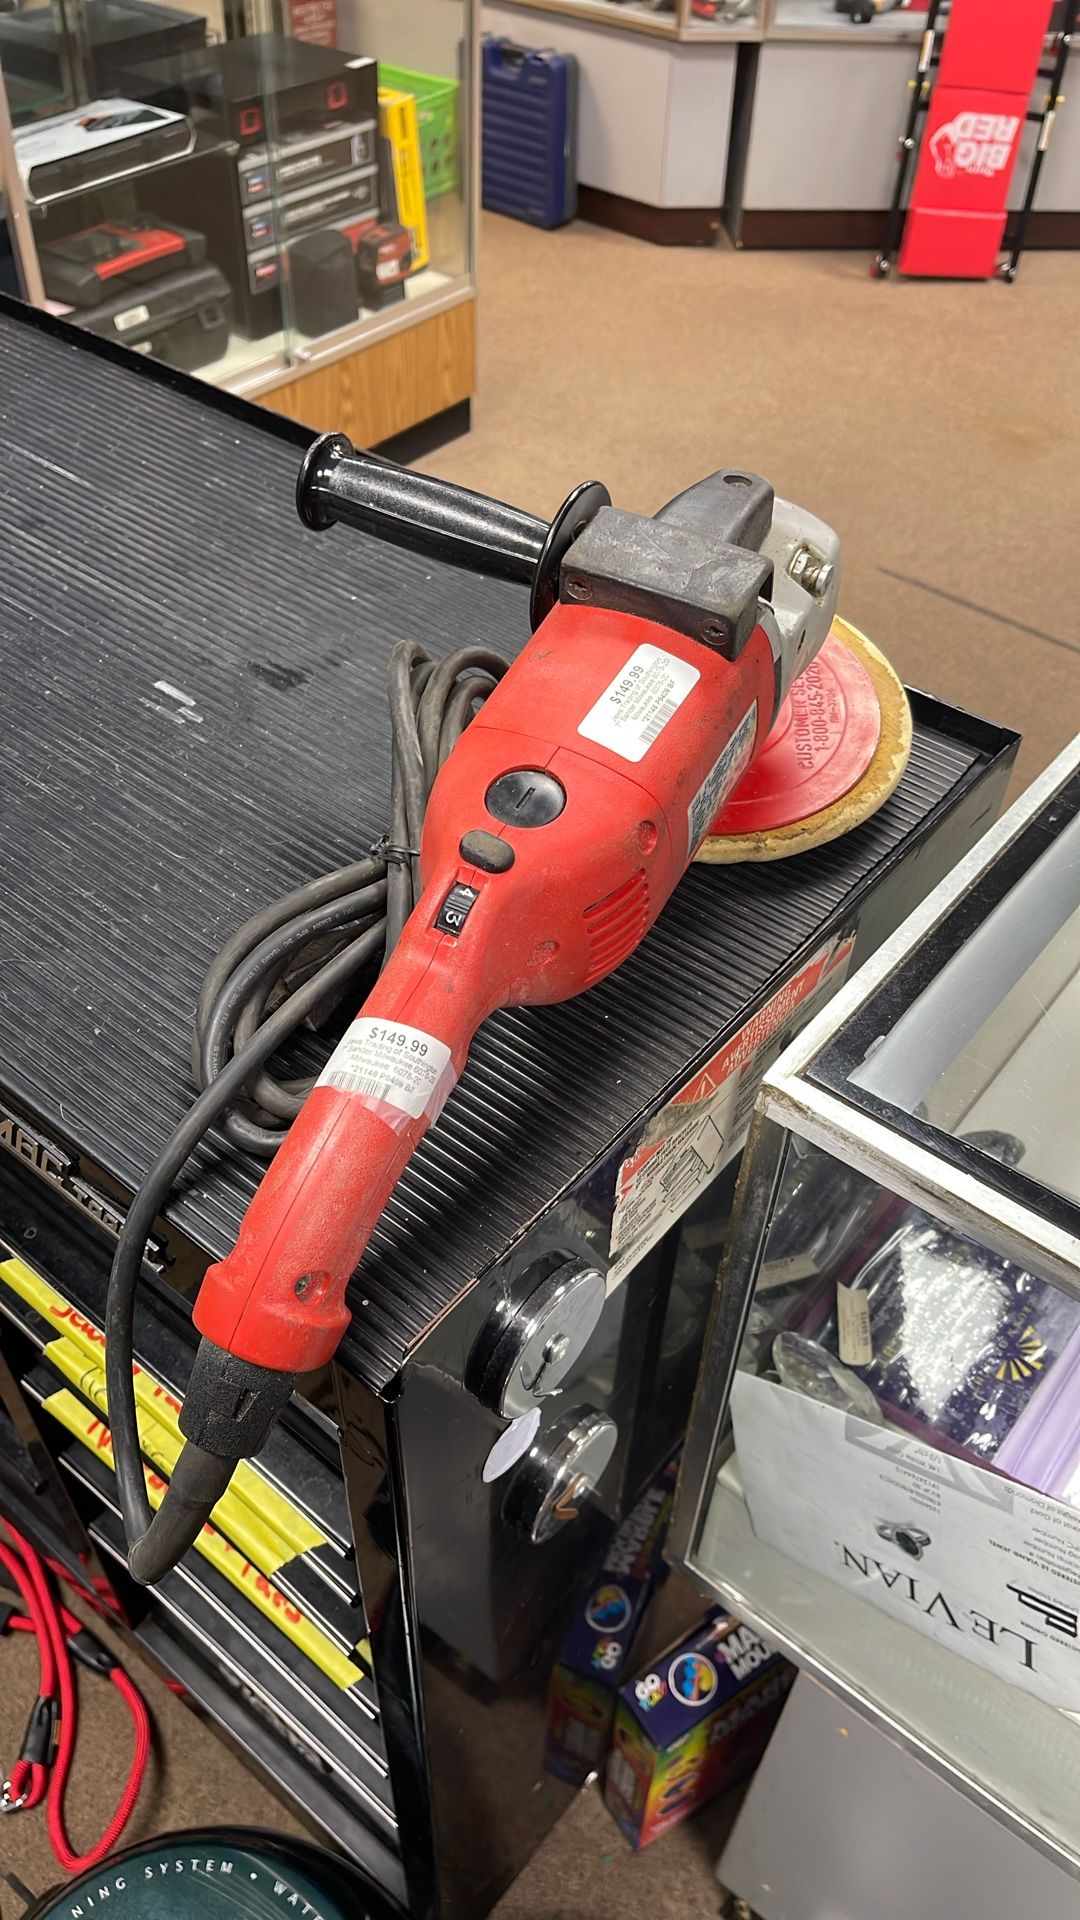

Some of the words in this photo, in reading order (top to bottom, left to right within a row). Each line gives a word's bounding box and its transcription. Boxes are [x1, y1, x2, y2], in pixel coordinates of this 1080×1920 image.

[951, 110, 1020, 144] RED
[952, 141, 1011, 169] BIG
[609, 663, 644, 705] $149.99
[459, 888, 474, 898] 4
[446, 911, 462, 926] 3
[741, 984, 791, 1040] WARNING
[364, 1038, 392, 1053] Trading
[369, 1027, 428, 1056] $149.99
[348, 1046, 374, 1056] Sander
[375, 1051, 413, 1071] Milwaukee
[351, 1054, 389, 1070] Milwaukee
[144, 1857, 234, 1880] SYSTEM
